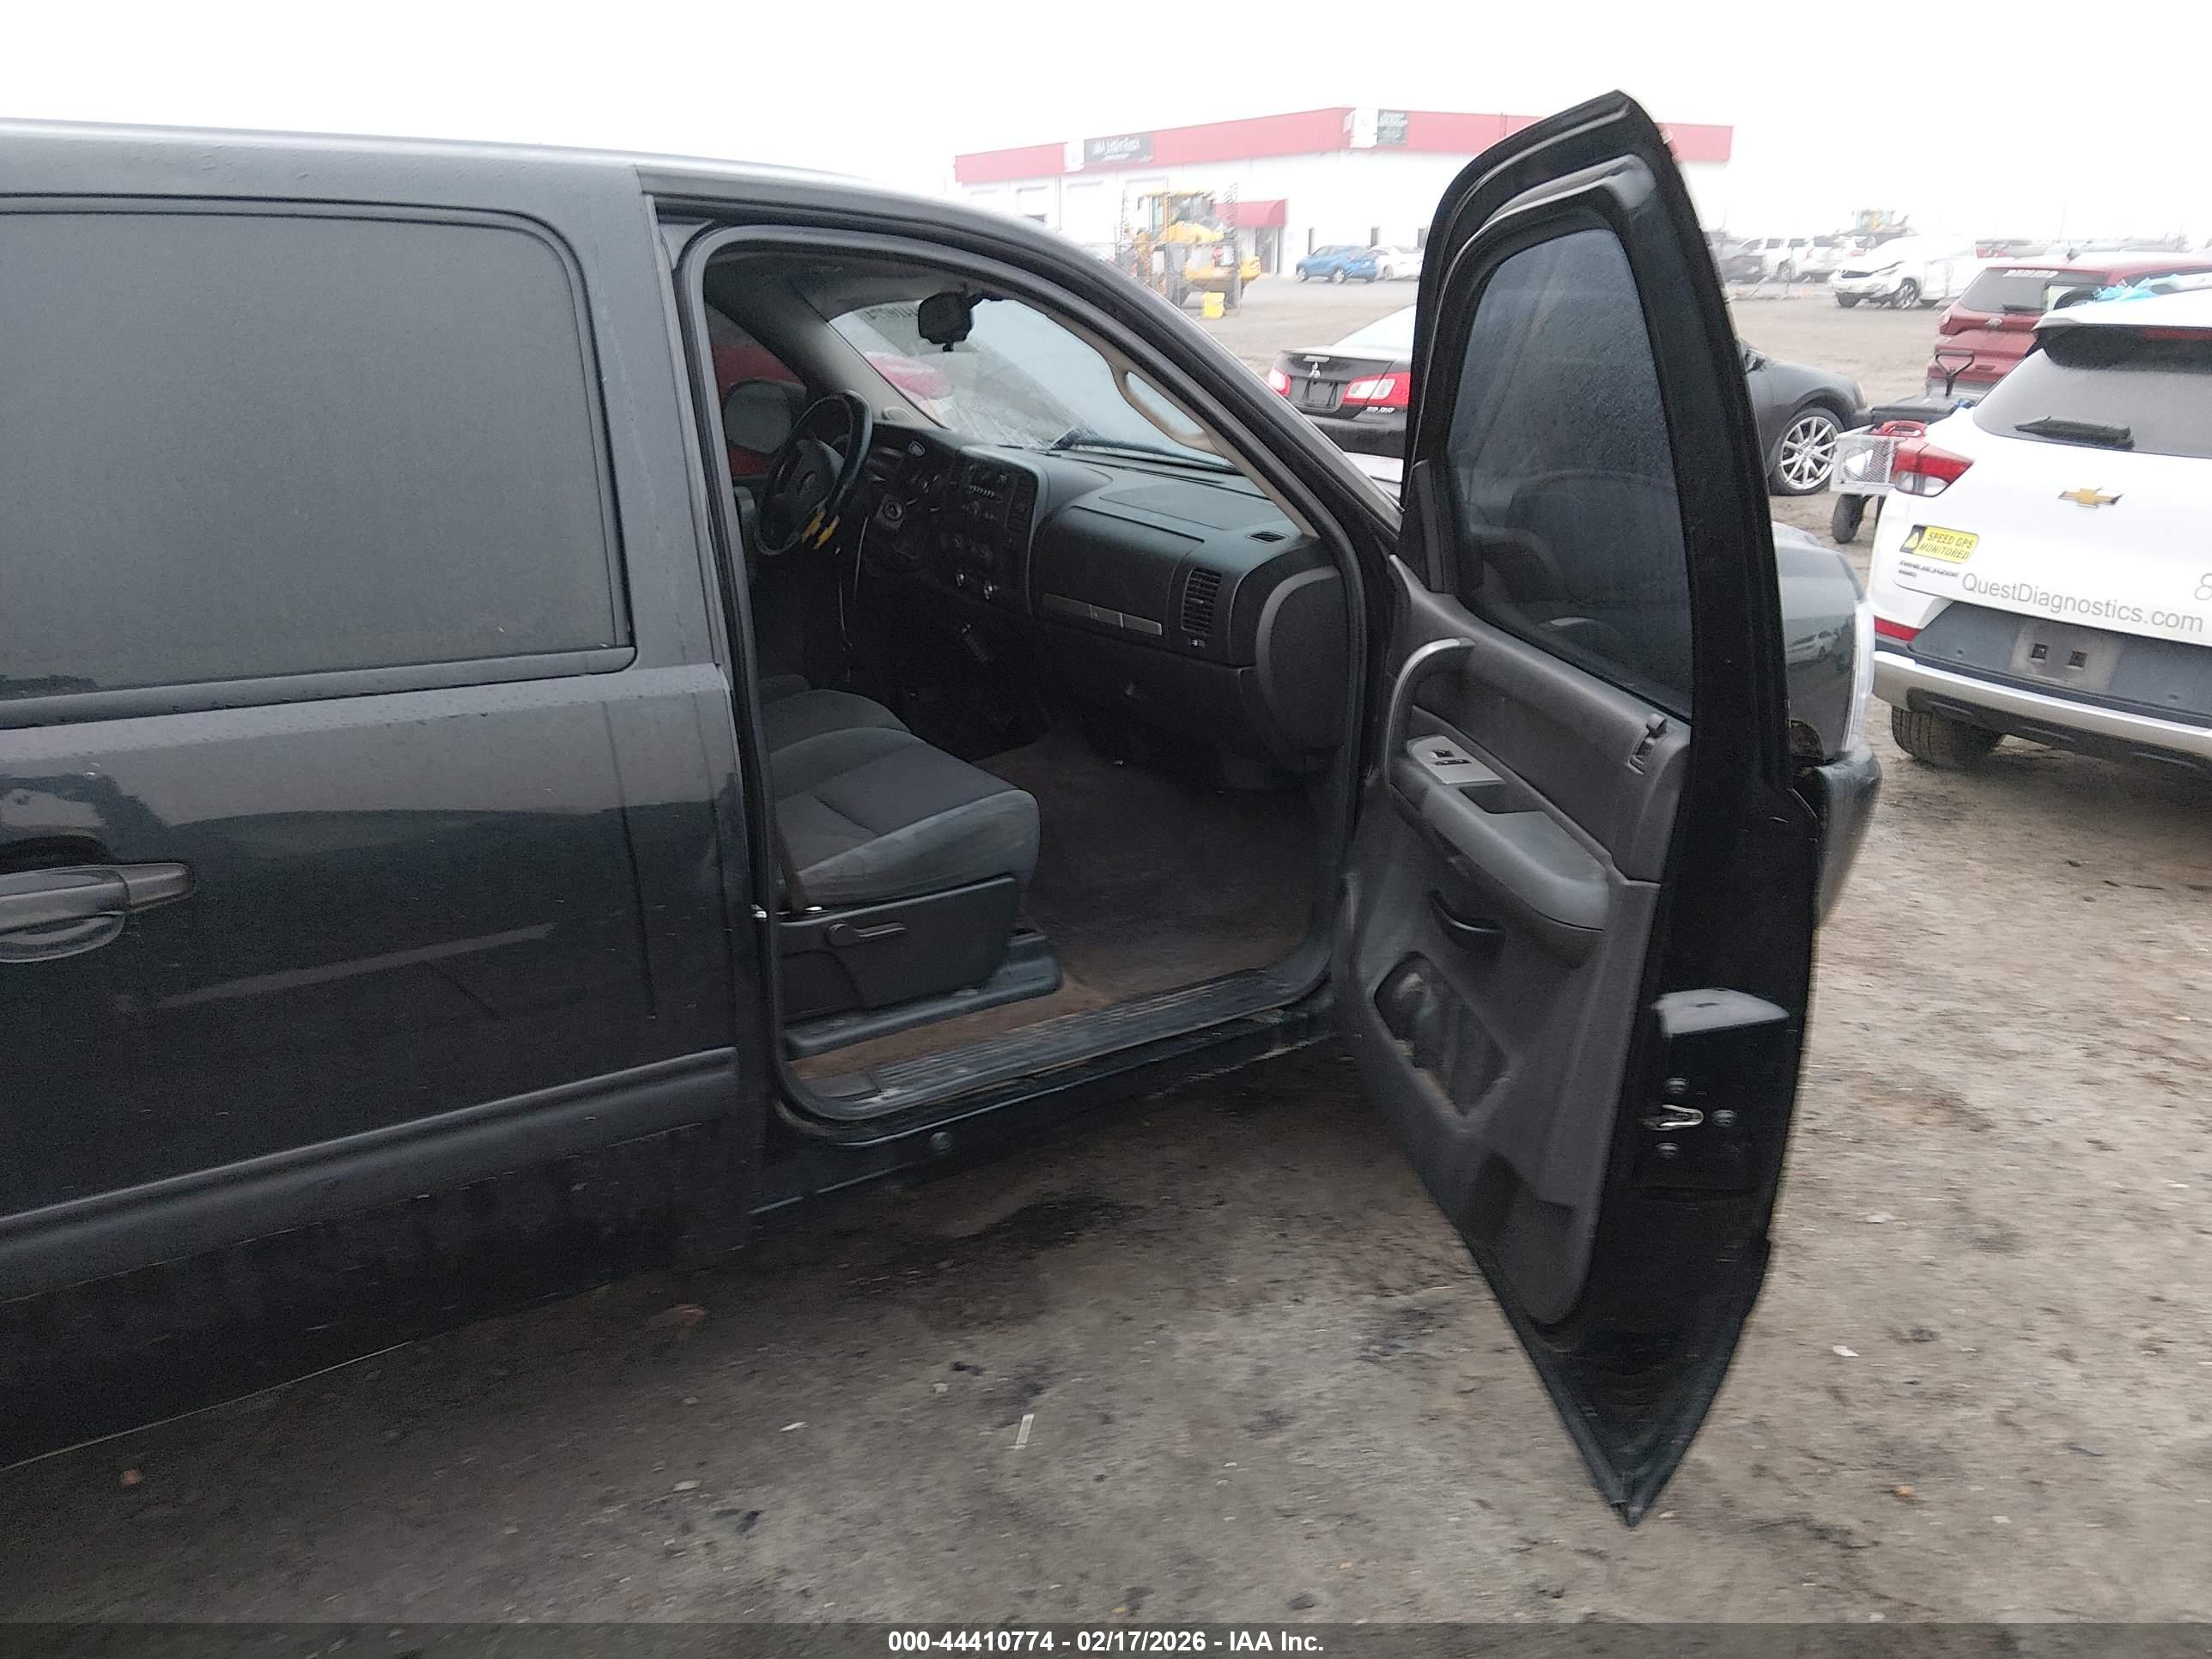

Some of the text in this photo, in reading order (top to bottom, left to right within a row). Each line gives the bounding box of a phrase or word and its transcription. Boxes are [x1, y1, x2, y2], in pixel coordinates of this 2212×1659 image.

[1927, 532, 1975, 550] SPEED GPS
[1918, 542, 1970, 560] MONITORED
[1962, 572, 2203, 633] QuestDiagnostics.com
